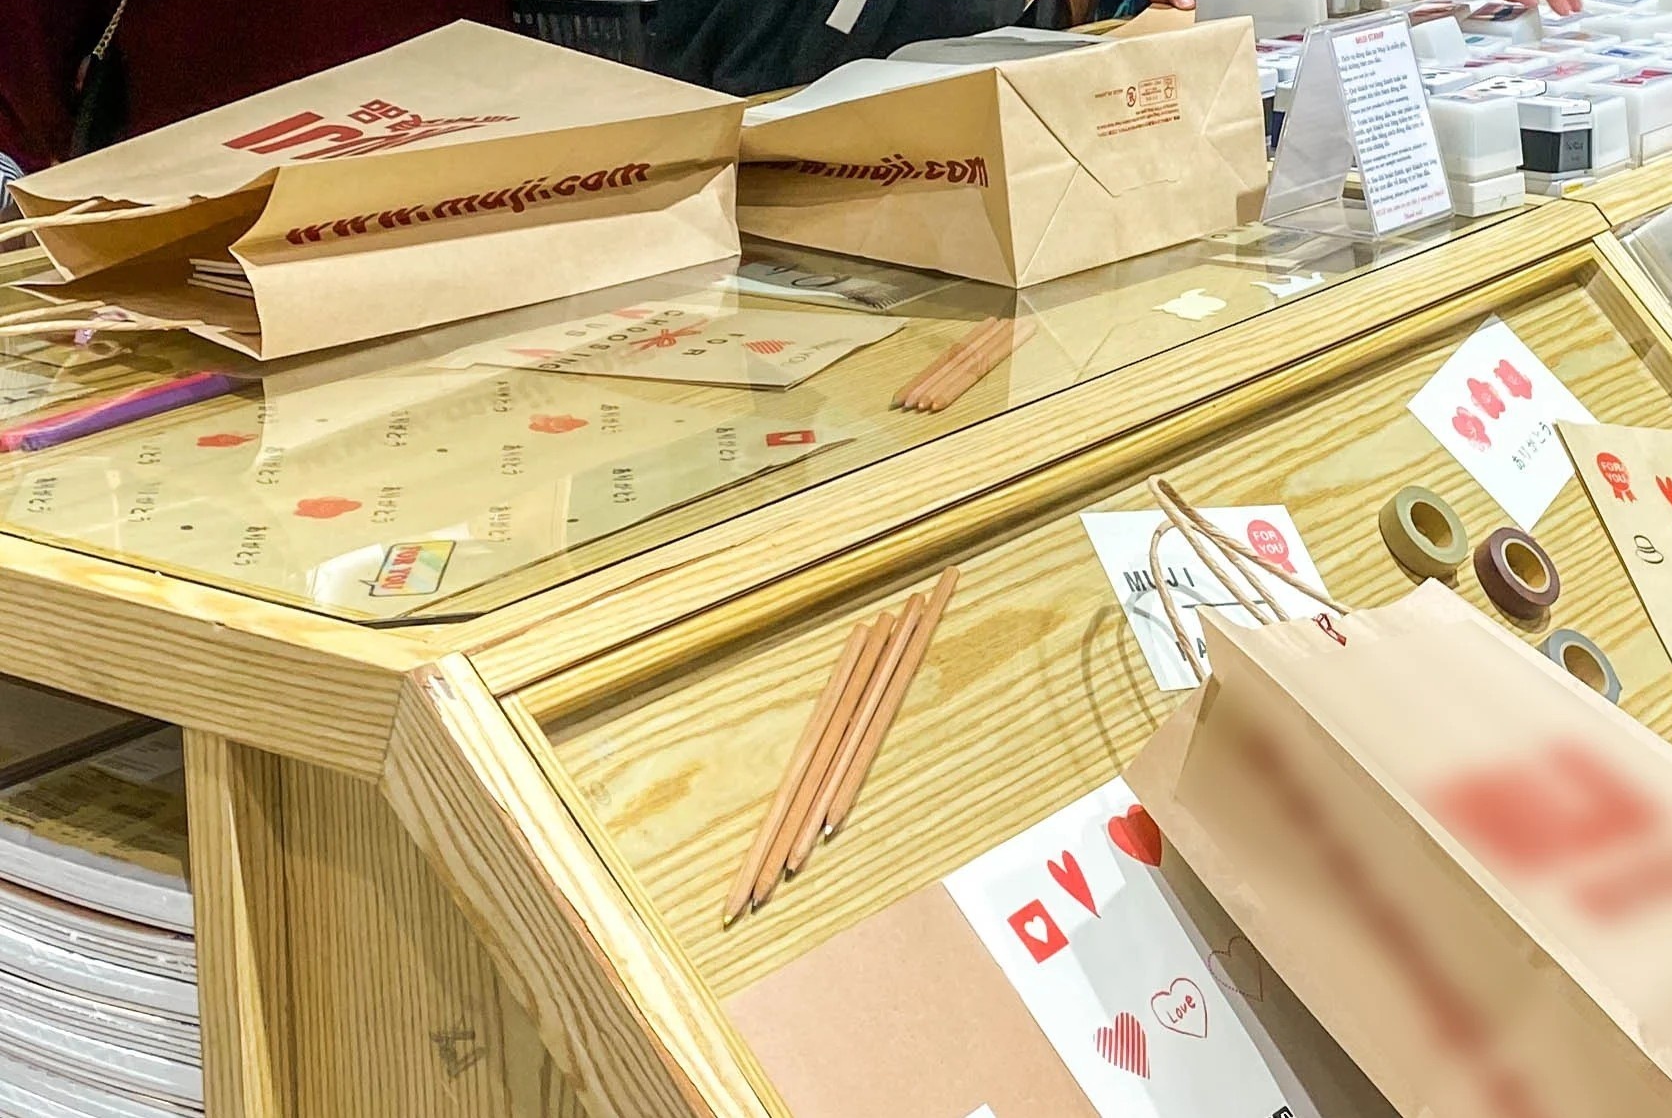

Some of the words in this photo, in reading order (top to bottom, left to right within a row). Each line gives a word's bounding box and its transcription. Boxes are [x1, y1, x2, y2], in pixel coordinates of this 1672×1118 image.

[1511, 421, 1552, 470] ありがとう
[1601, 460, 1625, 472] FOR
[1606, 472, 1627, 483] YOU
[1252, 529, 1278, 541] FOR
[1258, 542, 1284, 555] YOU
[1166, 994, 1196, 1024] Love
